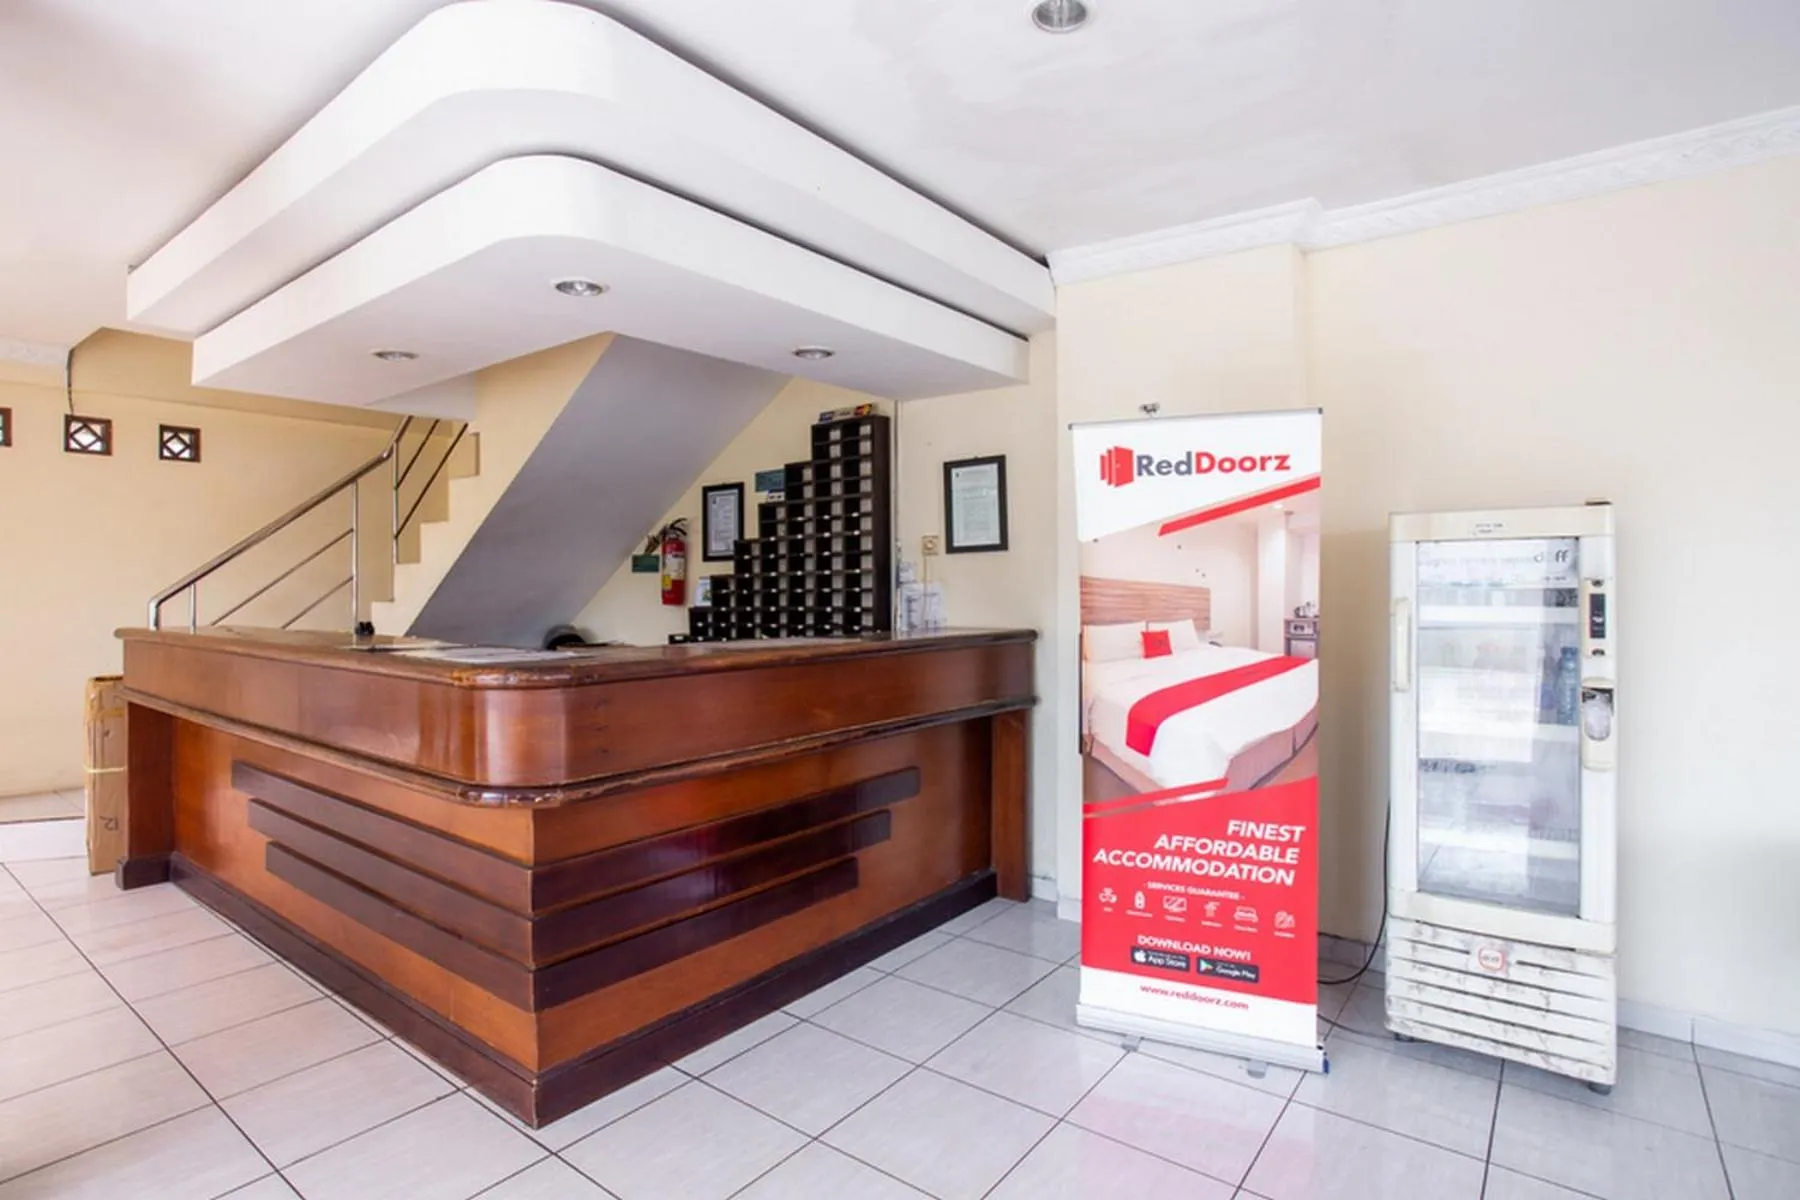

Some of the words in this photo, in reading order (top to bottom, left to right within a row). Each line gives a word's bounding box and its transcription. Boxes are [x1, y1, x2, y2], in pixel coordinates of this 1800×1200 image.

[1136, 451, 1291, 477] RedDoorz
[1227, 819, 1305, 843] FINEST
[1153, 833, 1300, 865] AFFORDABLE
[1093, 848, 1296, 886] ACCOMMODATION
[1147, 881, 1186, 894] SERVICES
[1137, 934, 1212, 955] DOWNLOAD
[1213, 946, 1252, 961] NOW!
[1147, 956, 1165, 966] App
[1166, 957, 1187, 969] Store
[1215, 965, 1241, 977] Google
[1242, 970, 1257, 980] Play
[1139, 985, 1250, 1010] www.reddoorz.com
